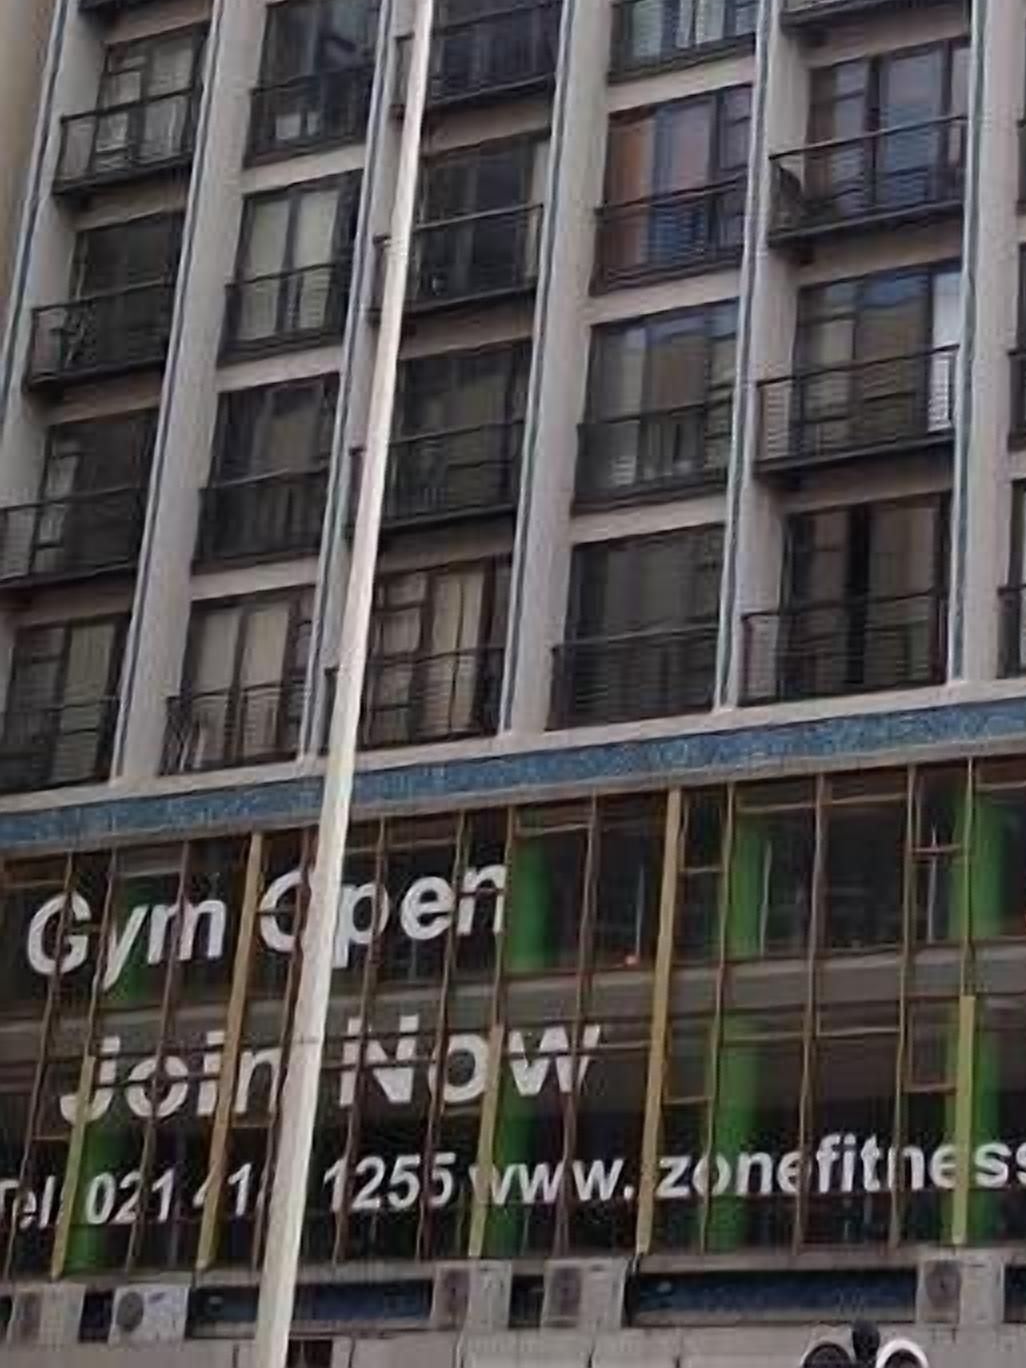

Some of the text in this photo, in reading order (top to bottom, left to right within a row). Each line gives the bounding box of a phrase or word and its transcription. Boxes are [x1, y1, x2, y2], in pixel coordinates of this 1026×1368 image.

[28, 863, 507, 992] Gym Open
[60, 1030, 283, 1126] Join
[84, 1166, 176, 1225] 021
[323, 1152, 456, 1213] 1255
